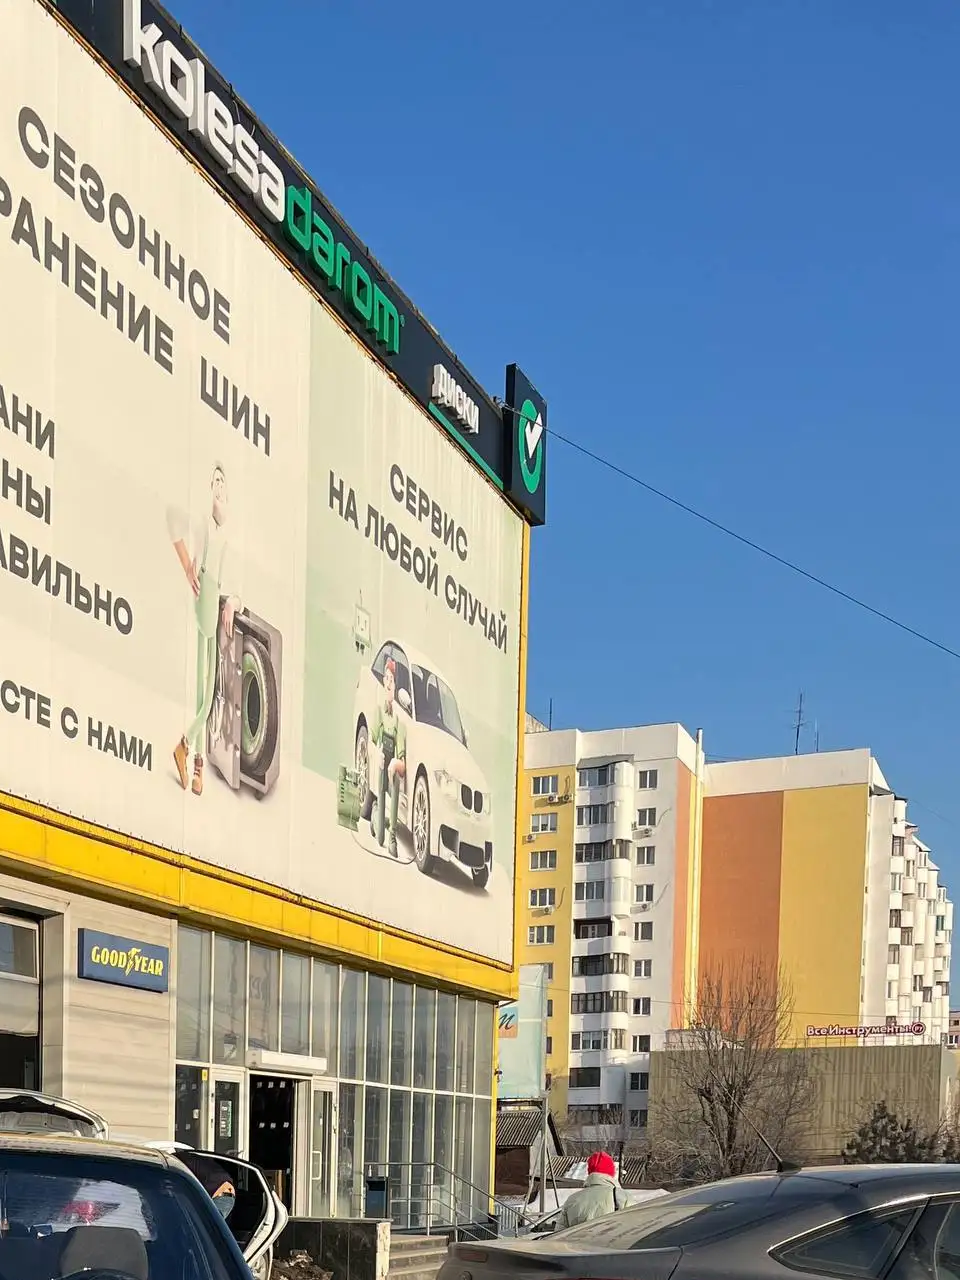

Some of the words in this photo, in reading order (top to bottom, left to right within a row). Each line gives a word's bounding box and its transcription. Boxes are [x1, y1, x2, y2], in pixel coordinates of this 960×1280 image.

[17, 106, 231, 345] СЕЗОННОЕ
[200, 355, 271, 457] ШИН
[431, 363, 480, 435] ДИСКИ
[328, 469, 360, 532] НА
[365, 503, 441, 599] ЛЮБОЙ
[444, 574, 508, 655] СЛУЧАЙ
[389, 463, 468, 562] СЕРВИС
[60, 706, 79, 739] С
[87, 716, 153, 772] НАМИ
